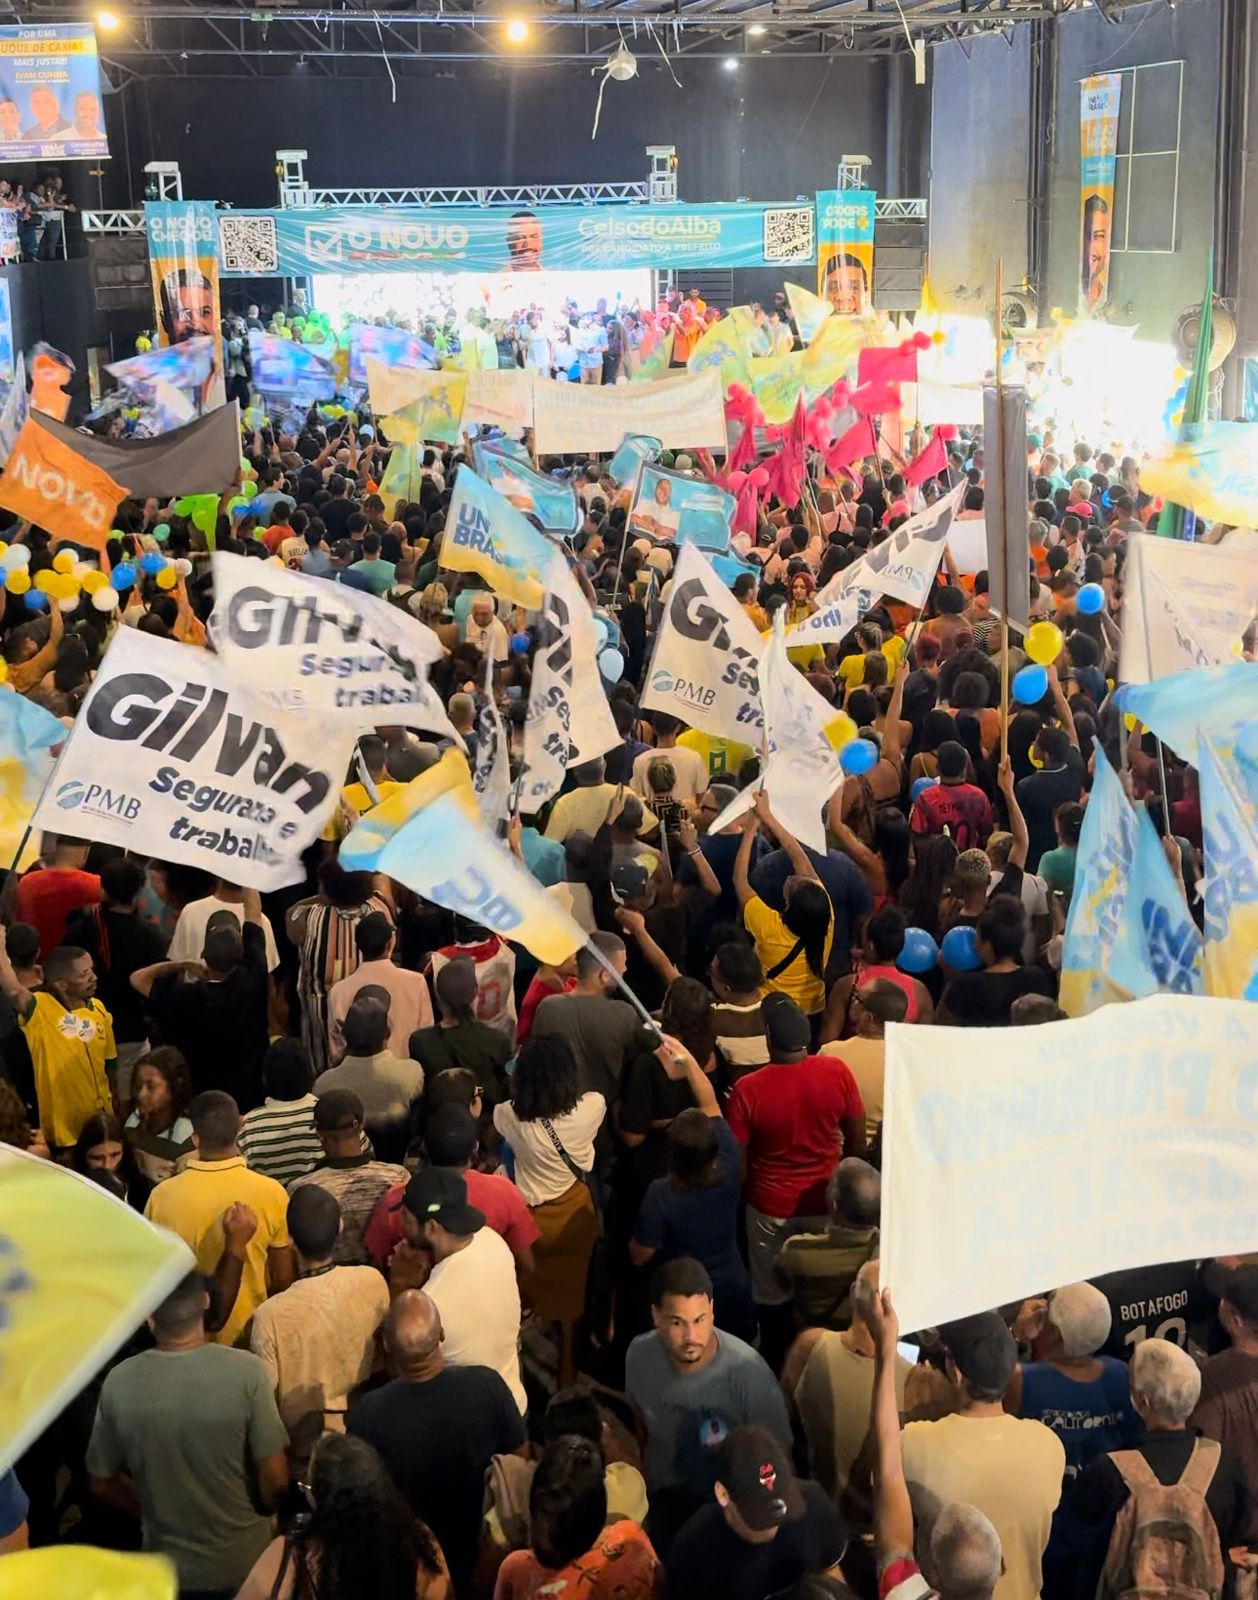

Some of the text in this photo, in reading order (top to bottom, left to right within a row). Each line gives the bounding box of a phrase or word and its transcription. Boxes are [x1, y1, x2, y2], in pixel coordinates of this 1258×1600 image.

[1, 42, 84, 53] UQUE DE CAXIAS
[825, 205, 868, 217] CAXIAS
[149, 216, 212, 230] O NOVO
[823, 217, 856, 229] PODE
[151, 230, 213, 242] CHEGOU
[350, 225, 470, 249] O NOVO
[674, 678, 716, 706] PMB
[86, 673, 330, 815] Gilvan
[84, 784, 142, 820] PMB
[1120, 1290, 1188, 1320] BOTAFOGO
